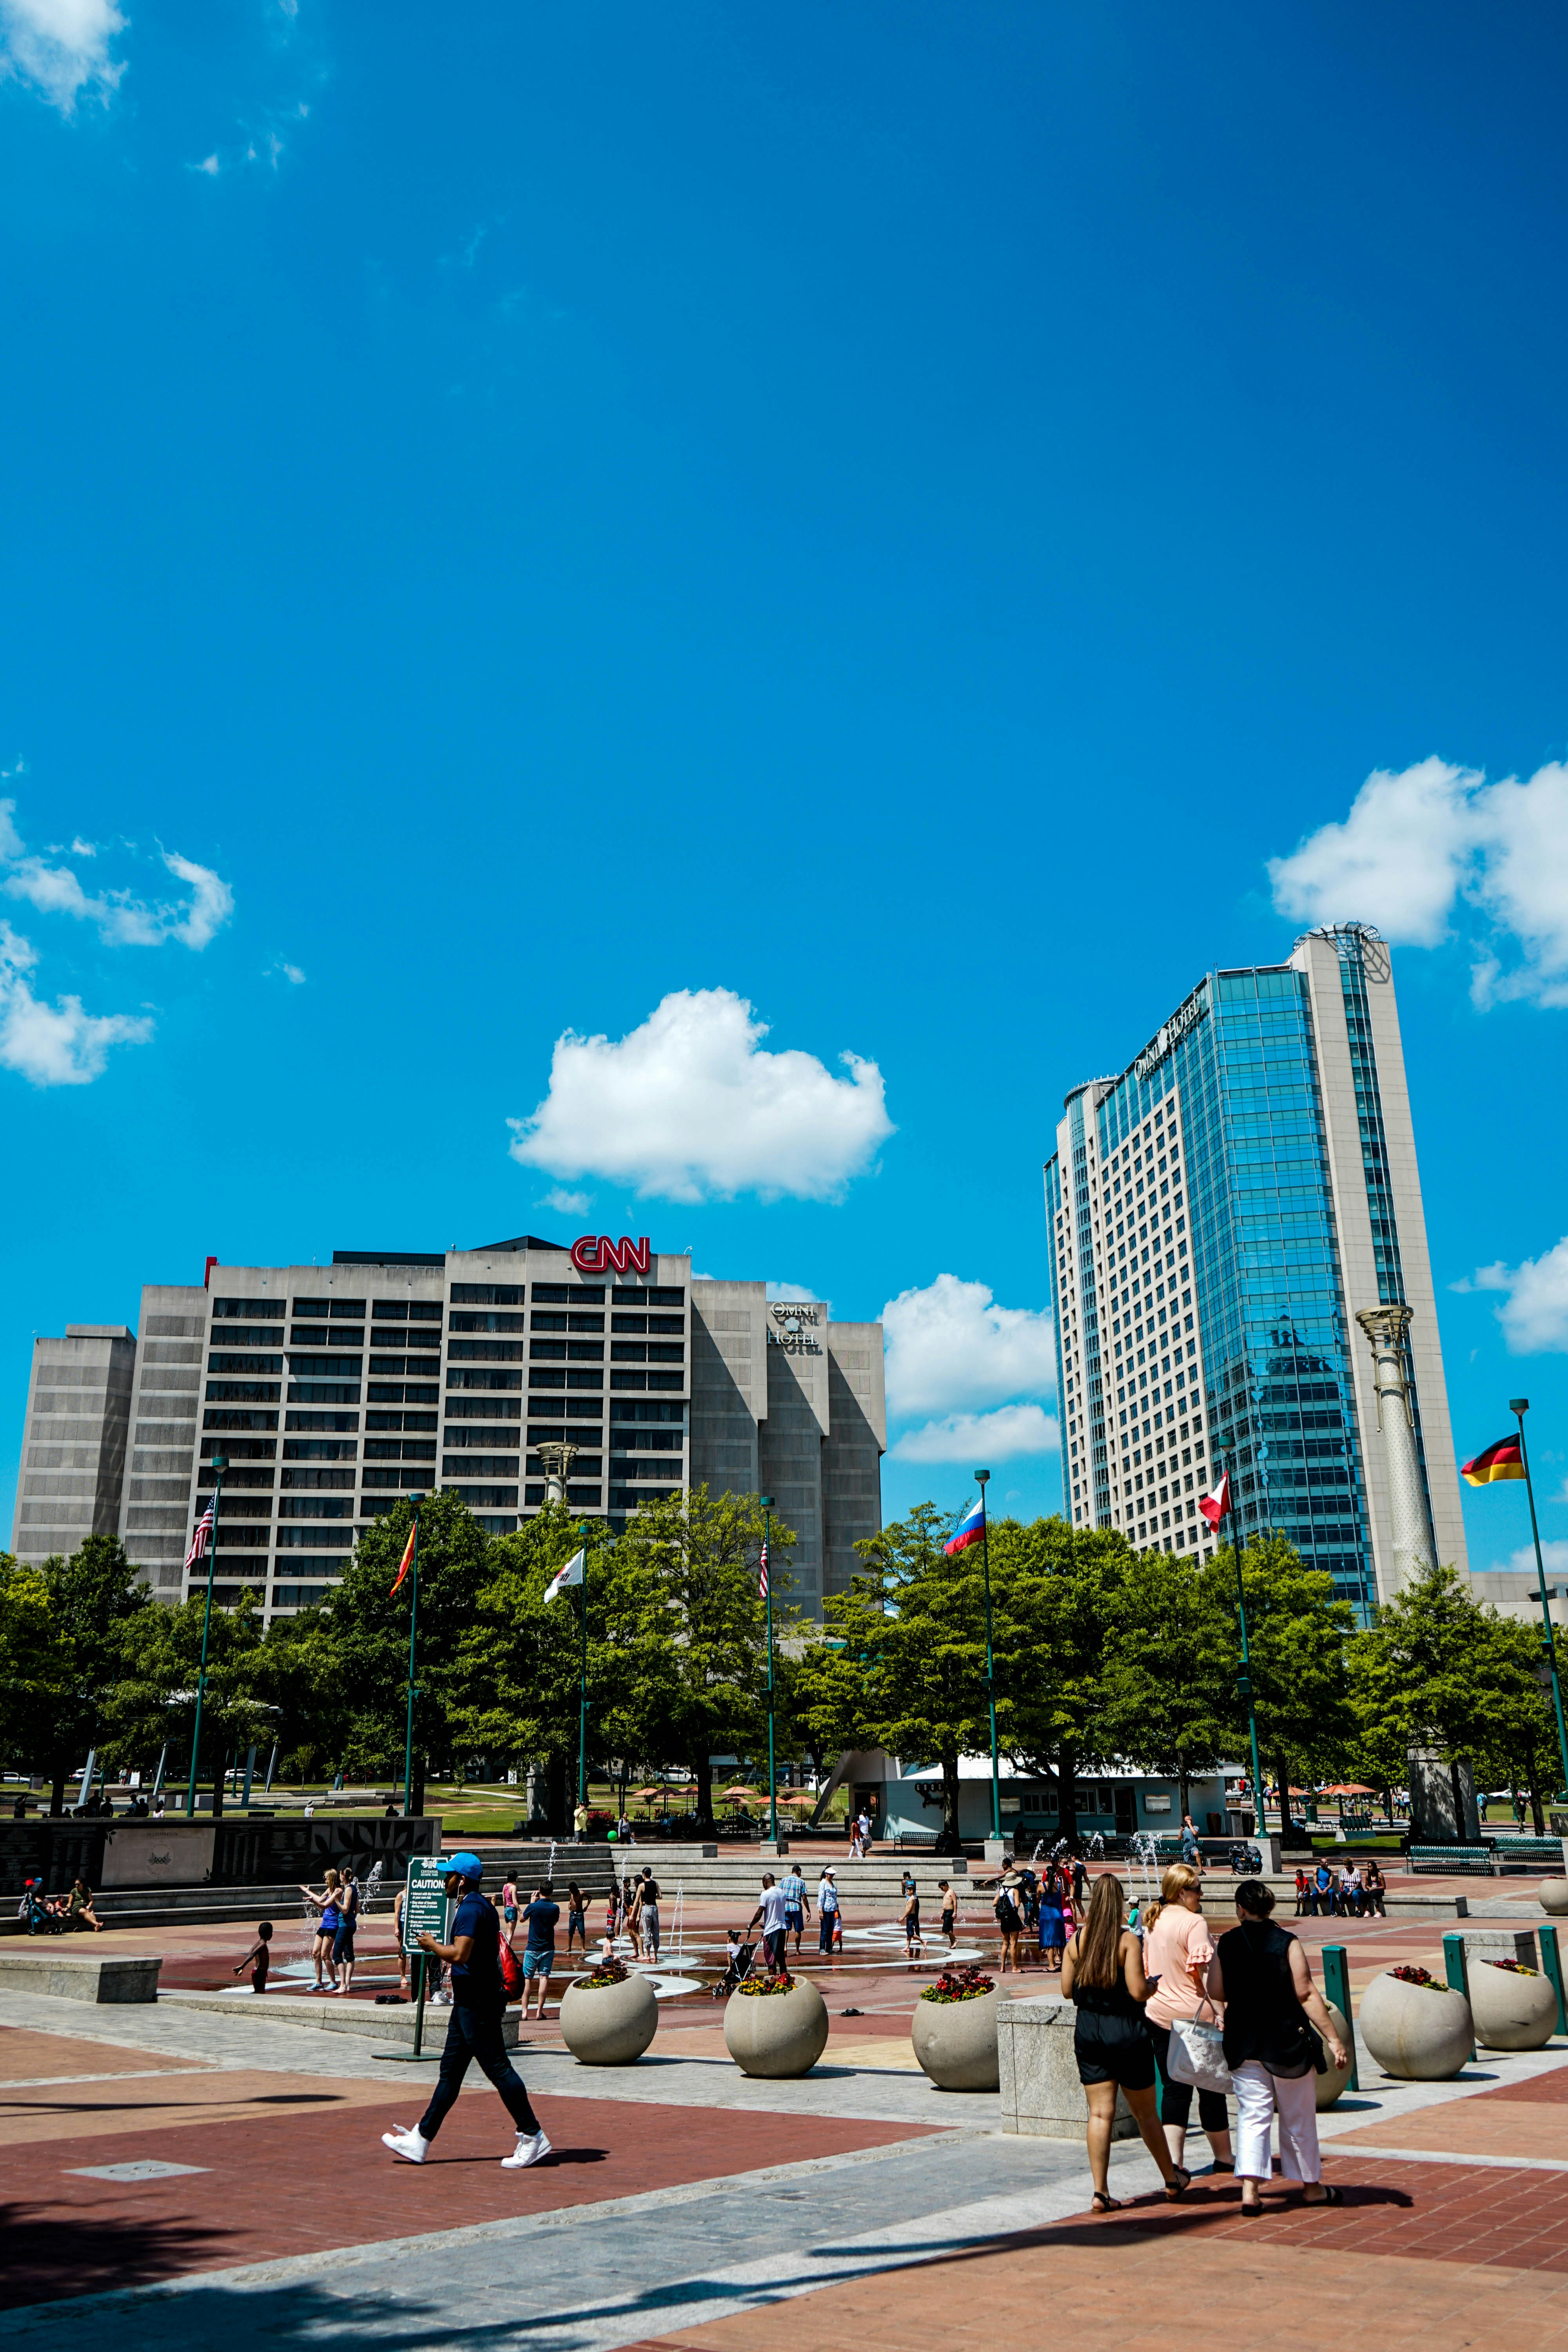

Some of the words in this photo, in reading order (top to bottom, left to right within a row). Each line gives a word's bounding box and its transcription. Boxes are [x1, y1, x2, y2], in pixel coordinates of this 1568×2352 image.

[1134, 1044, 1160, 1081] OMNI
[1168, 999, 1199, 1045] HOTEL
[571, 1235, 650, 1273] CNN
[771, 1302, 815, 1316] OMNI
[766, 1330, 819, 1345] HOTEL
